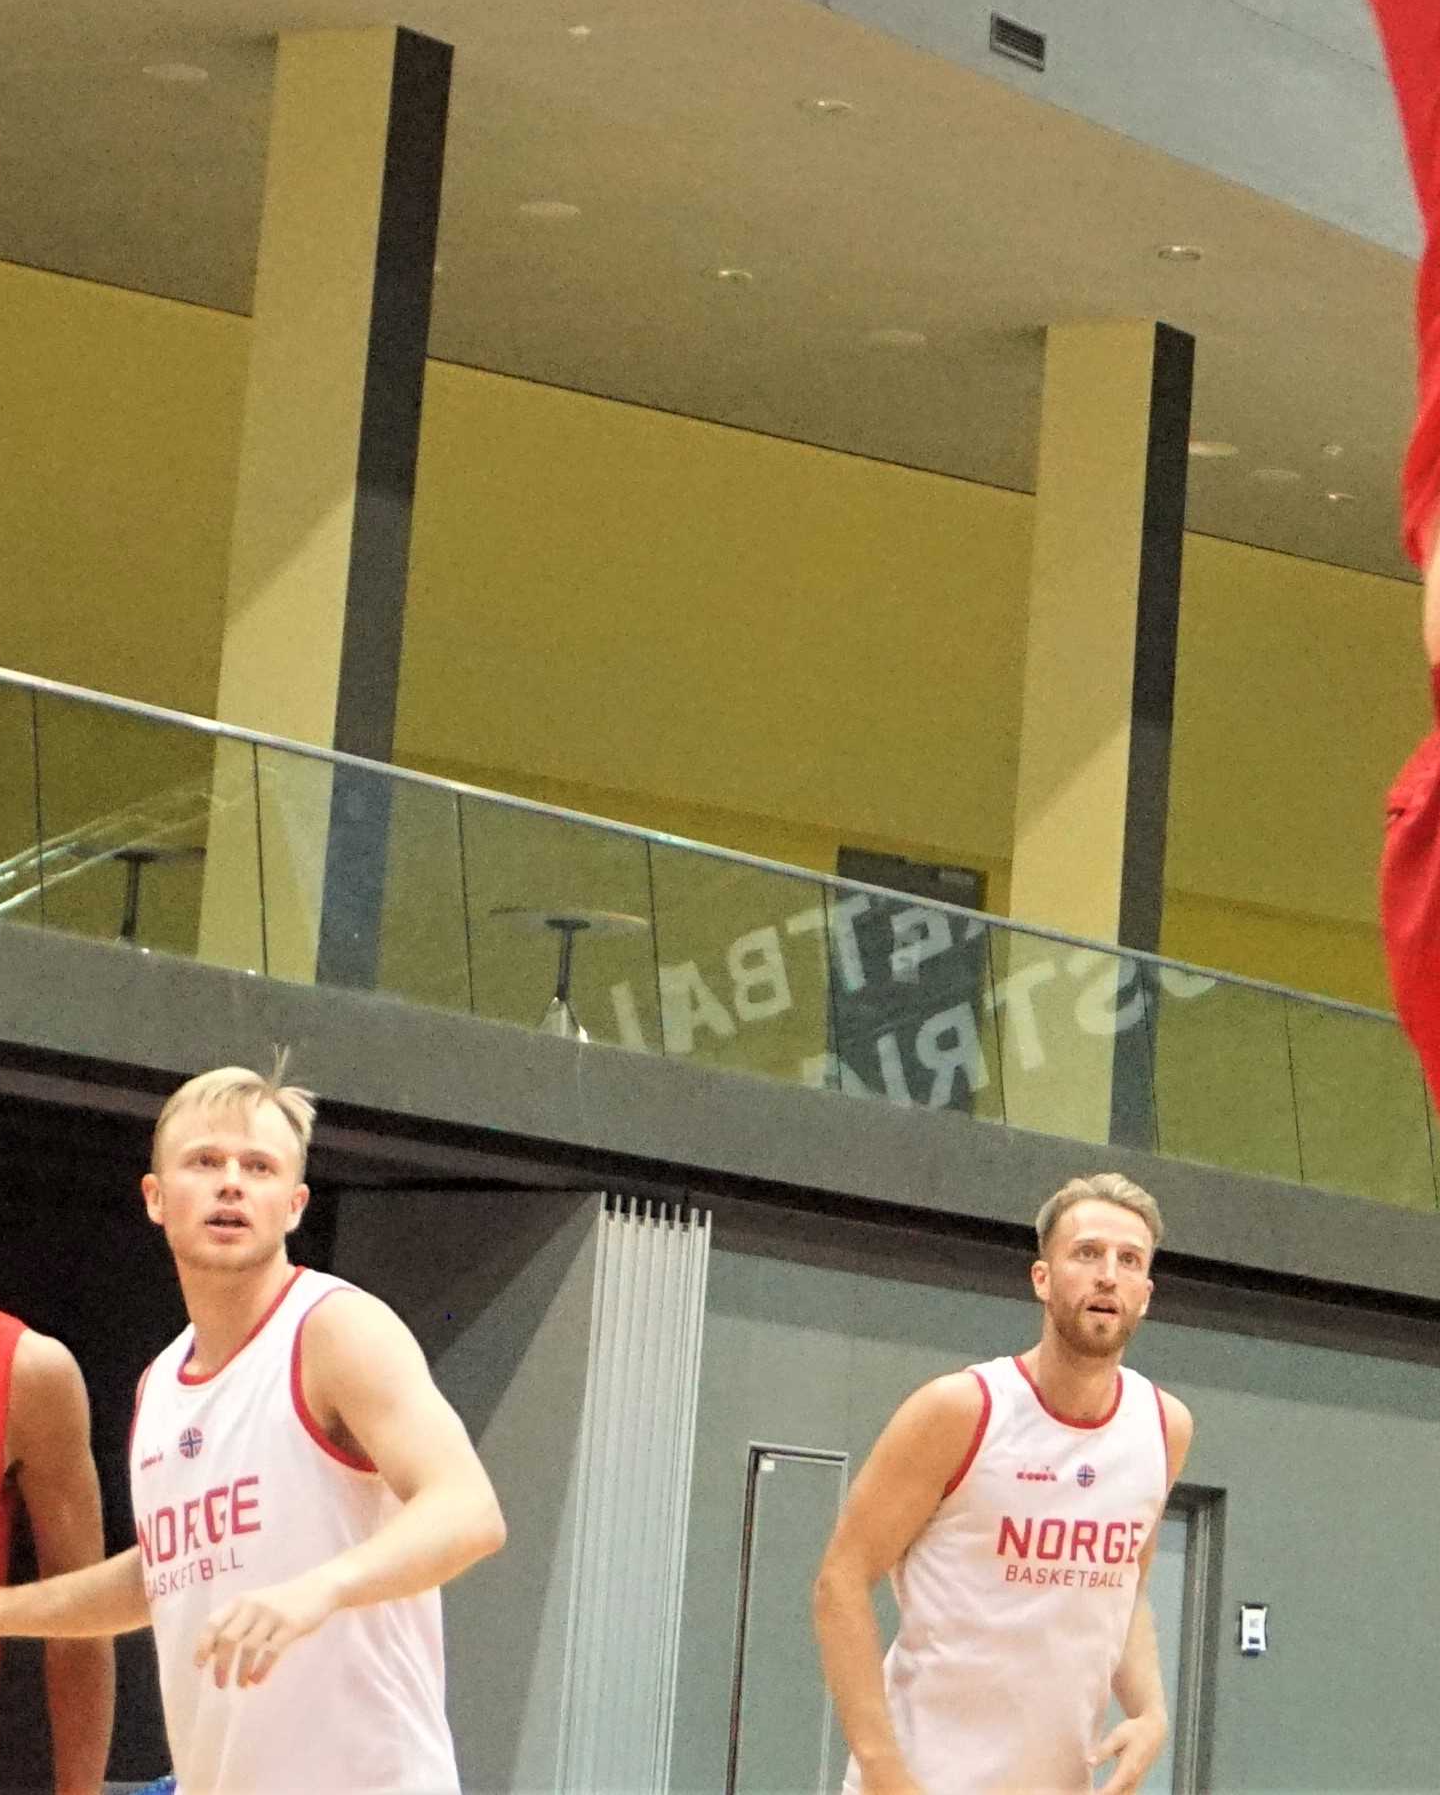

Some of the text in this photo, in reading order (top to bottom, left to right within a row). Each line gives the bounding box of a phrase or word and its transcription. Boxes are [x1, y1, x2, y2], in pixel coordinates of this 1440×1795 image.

[137, 1475, 261, 1568] NORGE
[996, 1515, 1145, 1565] NORGE
[1005, 1564, 1123, 1588] BASKETBALL
